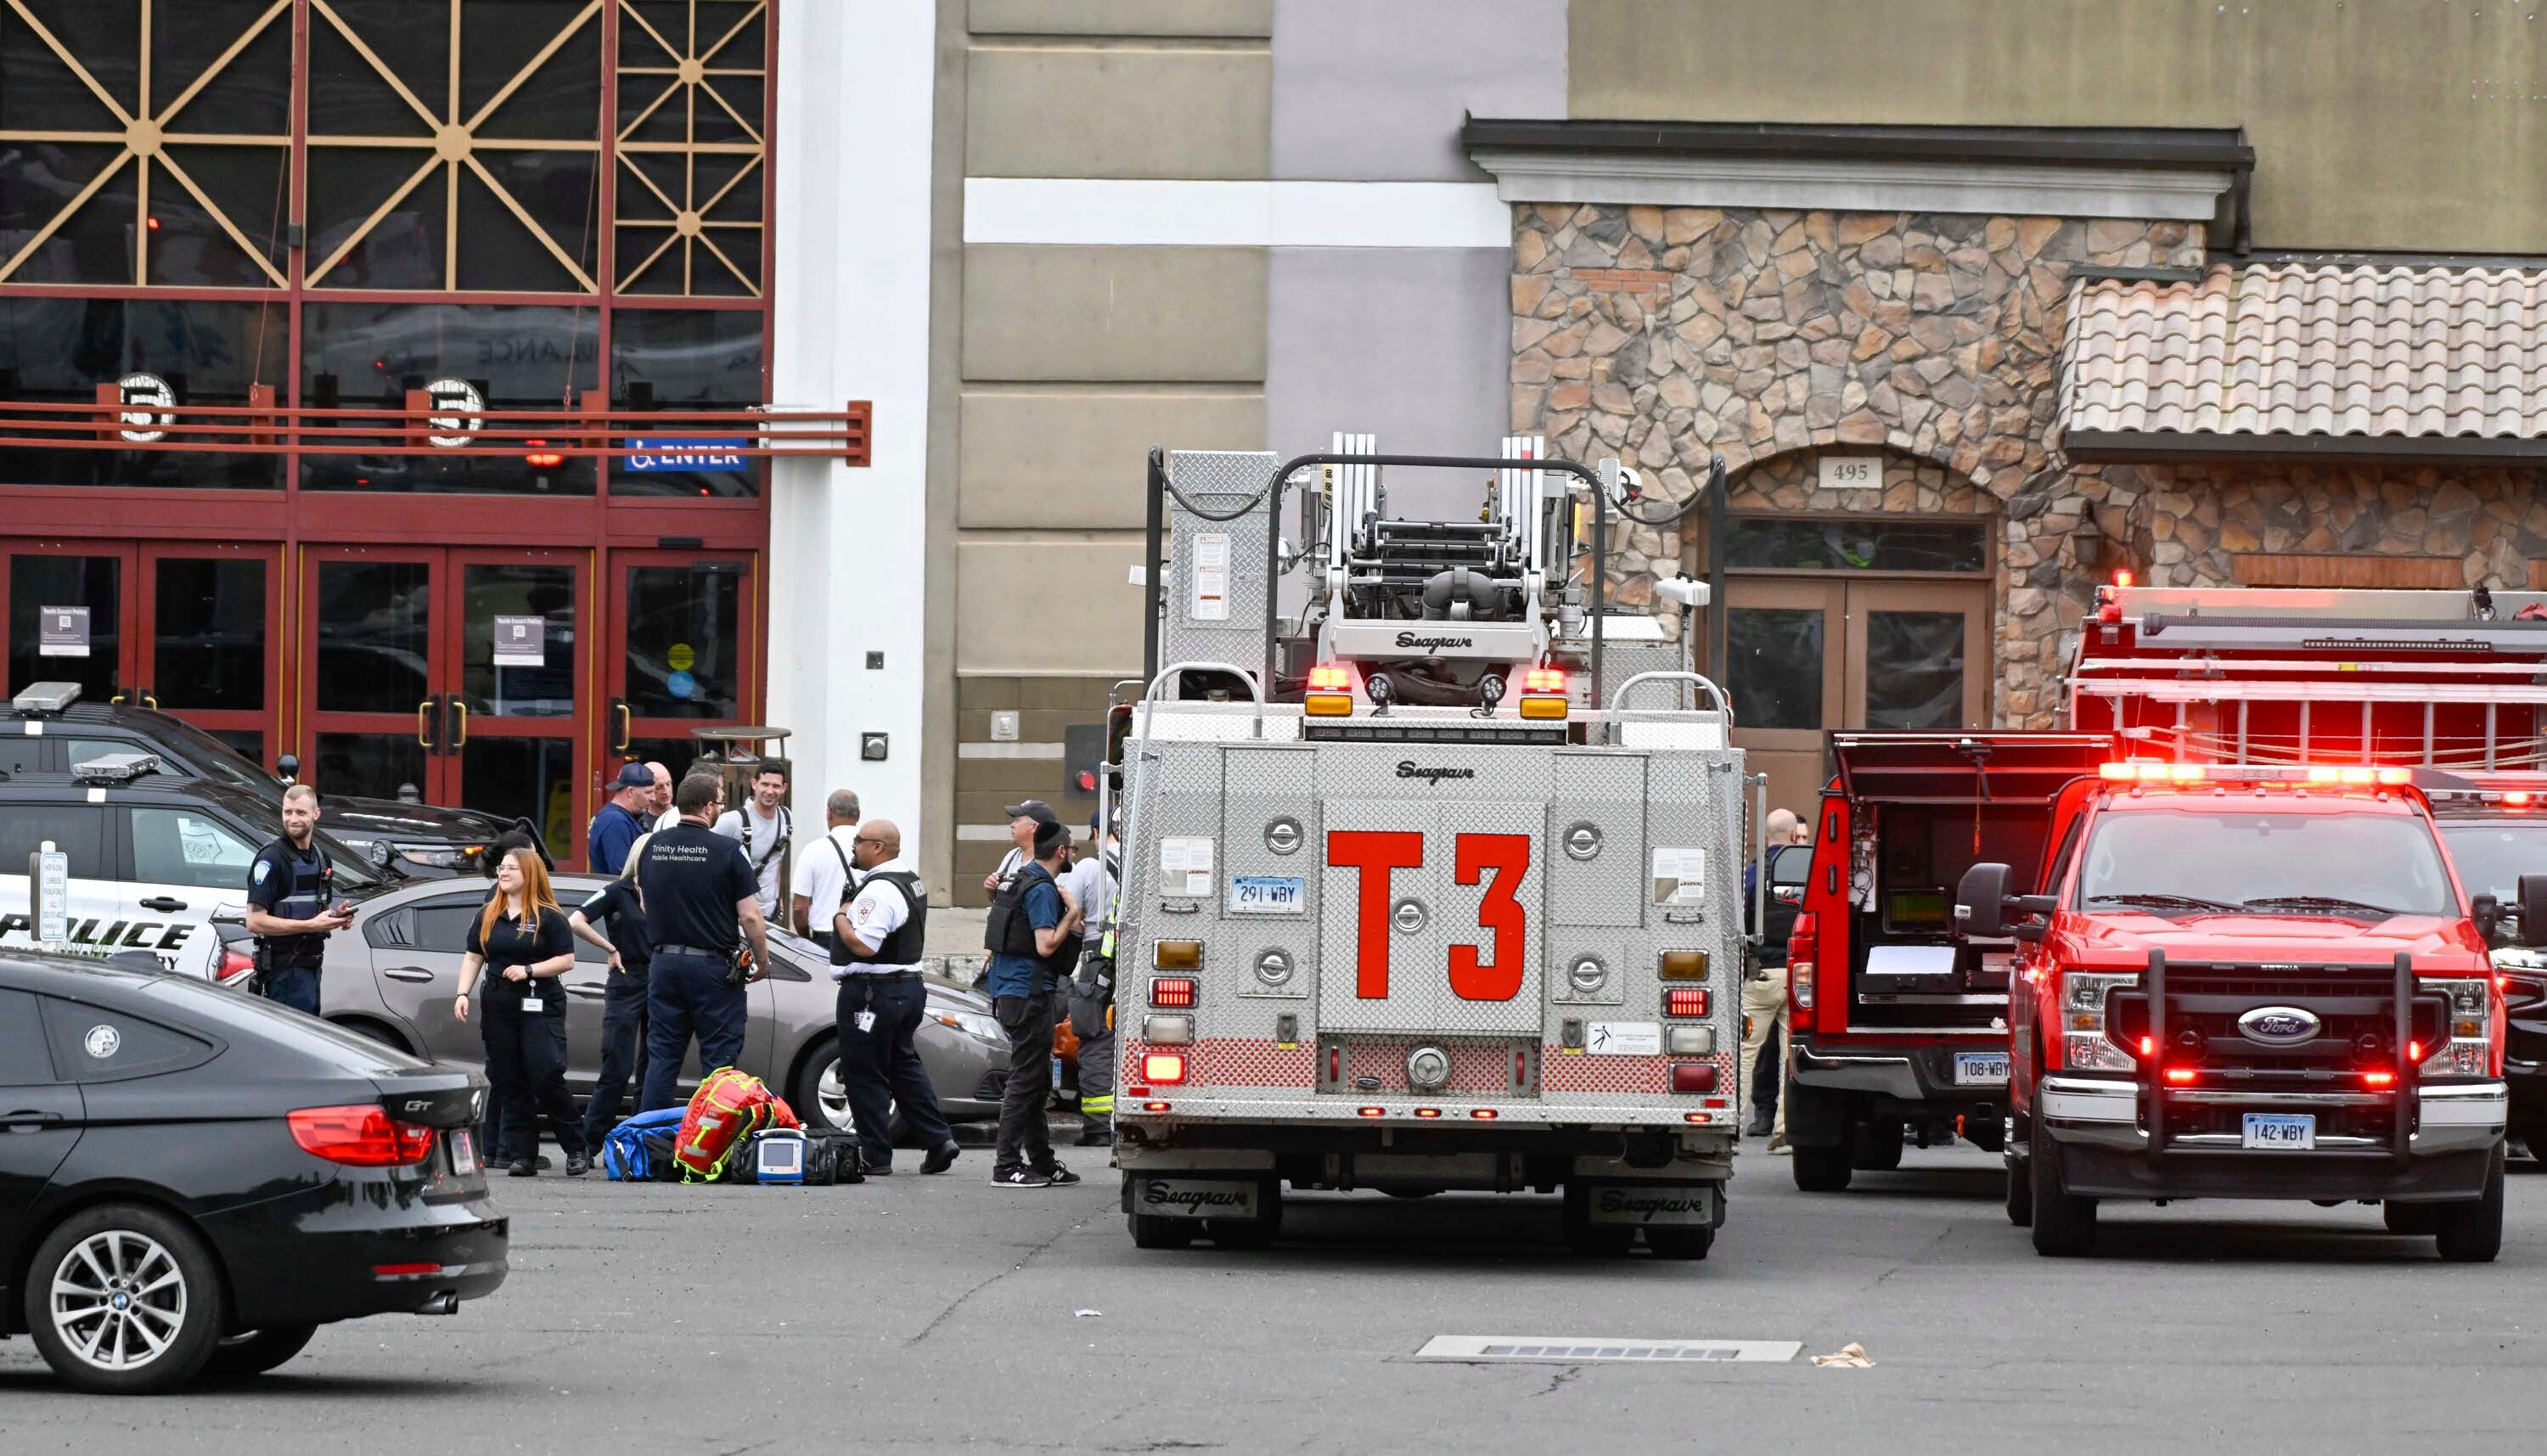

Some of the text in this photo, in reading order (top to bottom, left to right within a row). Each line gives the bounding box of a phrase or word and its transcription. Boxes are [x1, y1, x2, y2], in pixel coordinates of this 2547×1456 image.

[661, 445, 739, 464] ENTER
[1834, 464, 1868, 481] 495
[1395, 631, 1473, 655] Seagrave
[1396, 761, 1475, 786] Seagrave
[652, 844, 708, 854] Trinity Health
[669, 854, 707, 863] Healthcare
[2260, 1016, 2300, 1033] Ford
[404, 1100, 434, 1112] GT
[1143, 1181, 1250, 1215] Seagrave
[1600, 1190, 1703, 1223] Seagrave
